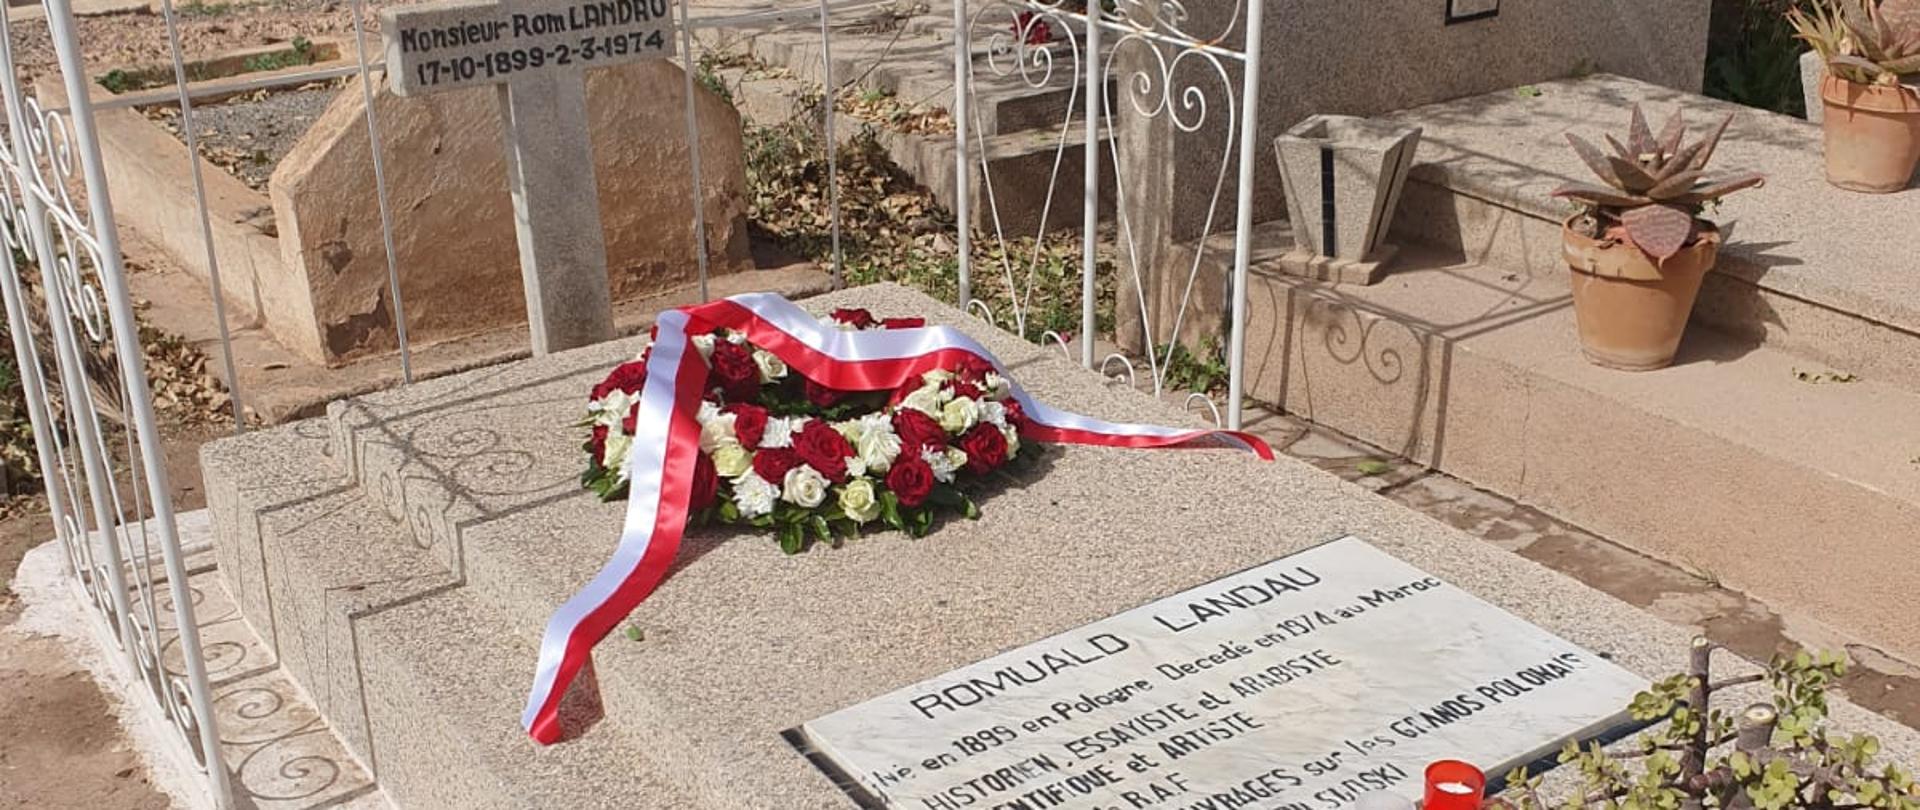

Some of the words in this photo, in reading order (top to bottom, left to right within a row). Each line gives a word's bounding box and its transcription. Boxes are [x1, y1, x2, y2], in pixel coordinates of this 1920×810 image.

[401, 21, 508, 52] Monsieur
[513, 13, 567, 37] Rom
[569, 0, 667, 30] LANDAU
[911, 632, 1129, 719] ROMUALD
[1153, 567, 1321, 632] LANDAU
[921, 752, 958, 770] en
[952, 725, 1017, 756] 1899
[1022, 716, 1059, 733] en
[1048, 679, 1153, 720] Pologne
[1254, 632, 1286, 648] en
[1277, 611, 1337, 637] 1974
[1334, 605, 1366, 618] au
[1357, 576, 1441, 608] Maroc
[1064, 703, 1198, 759] ESSAYISTE
[1198, 691, 1231, 710] et
[1229, 649, 1342, 698] ARABISTE
[1126, 753, 1160, 773] et
[1303, 751, 1345, 776] sur
